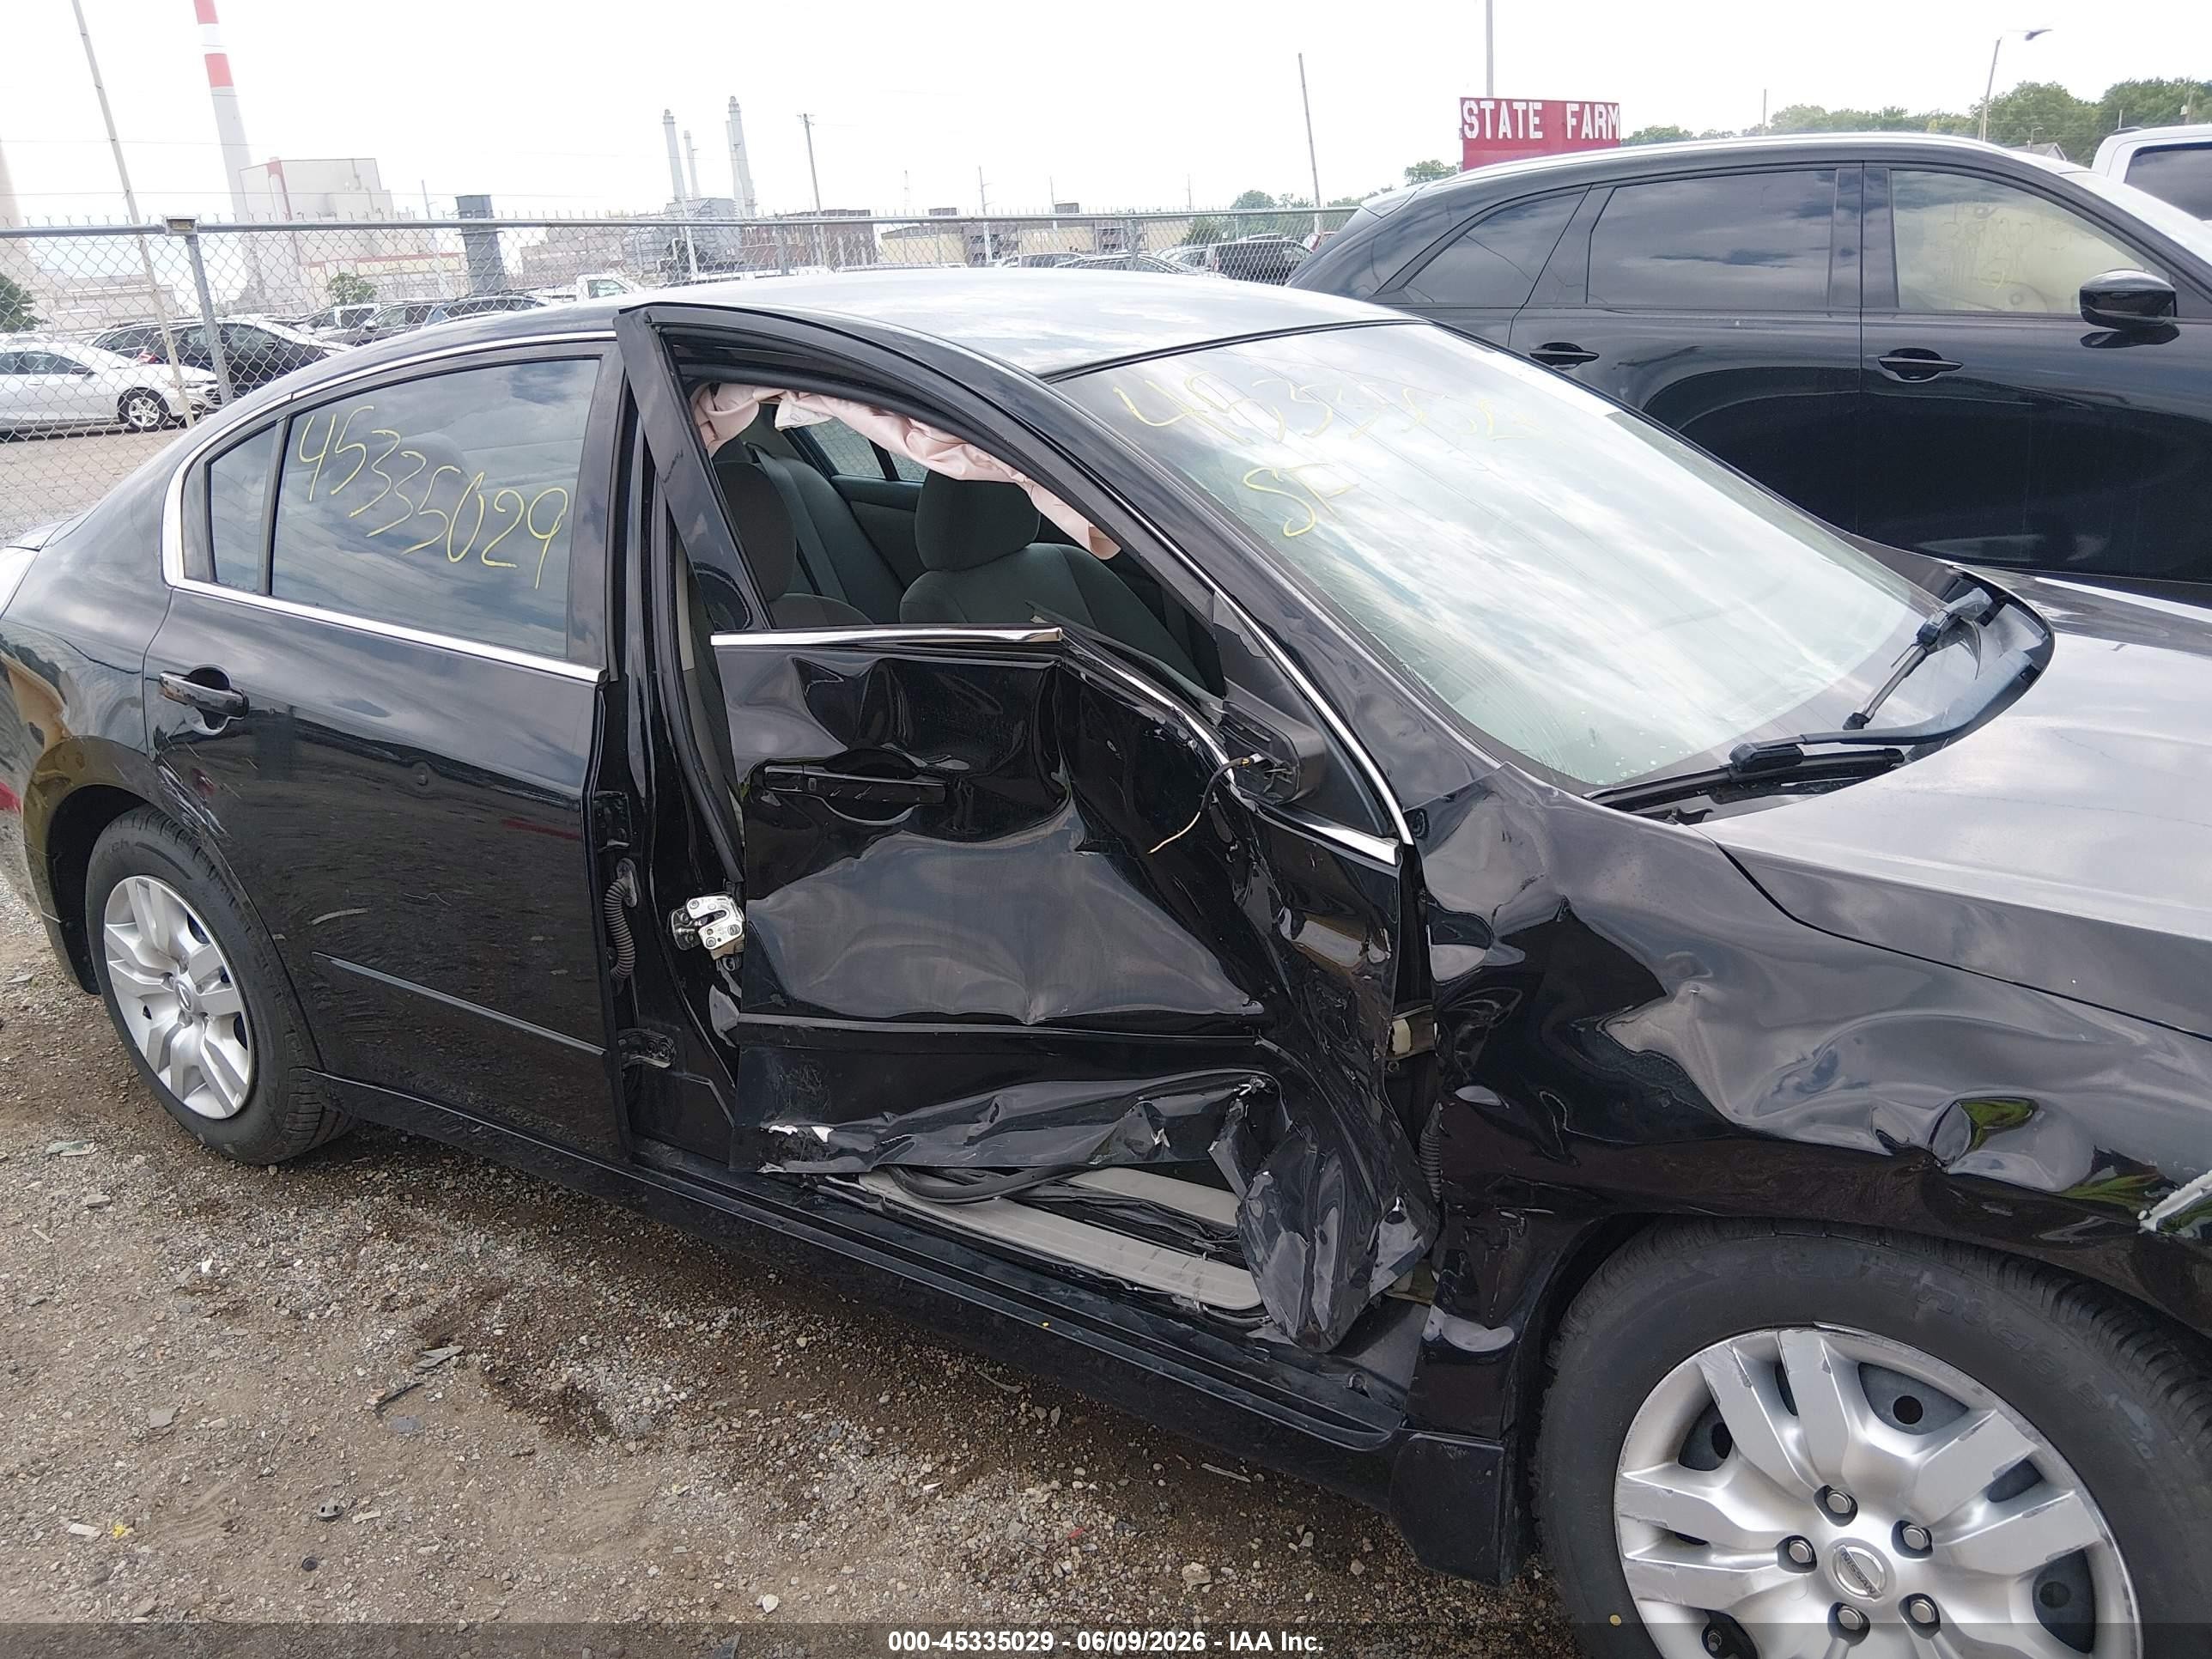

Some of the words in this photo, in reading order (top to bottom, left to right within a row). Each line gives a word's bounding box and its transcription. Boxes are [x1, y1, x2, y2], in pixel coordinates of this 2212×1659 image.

[1462, 100, 1543, 140] STATE
[1565, 102, 1620, 140] FARM
[298, 404, 568, 590] 45335029
[1839, 1547, 1877, 1595] NISSAN
